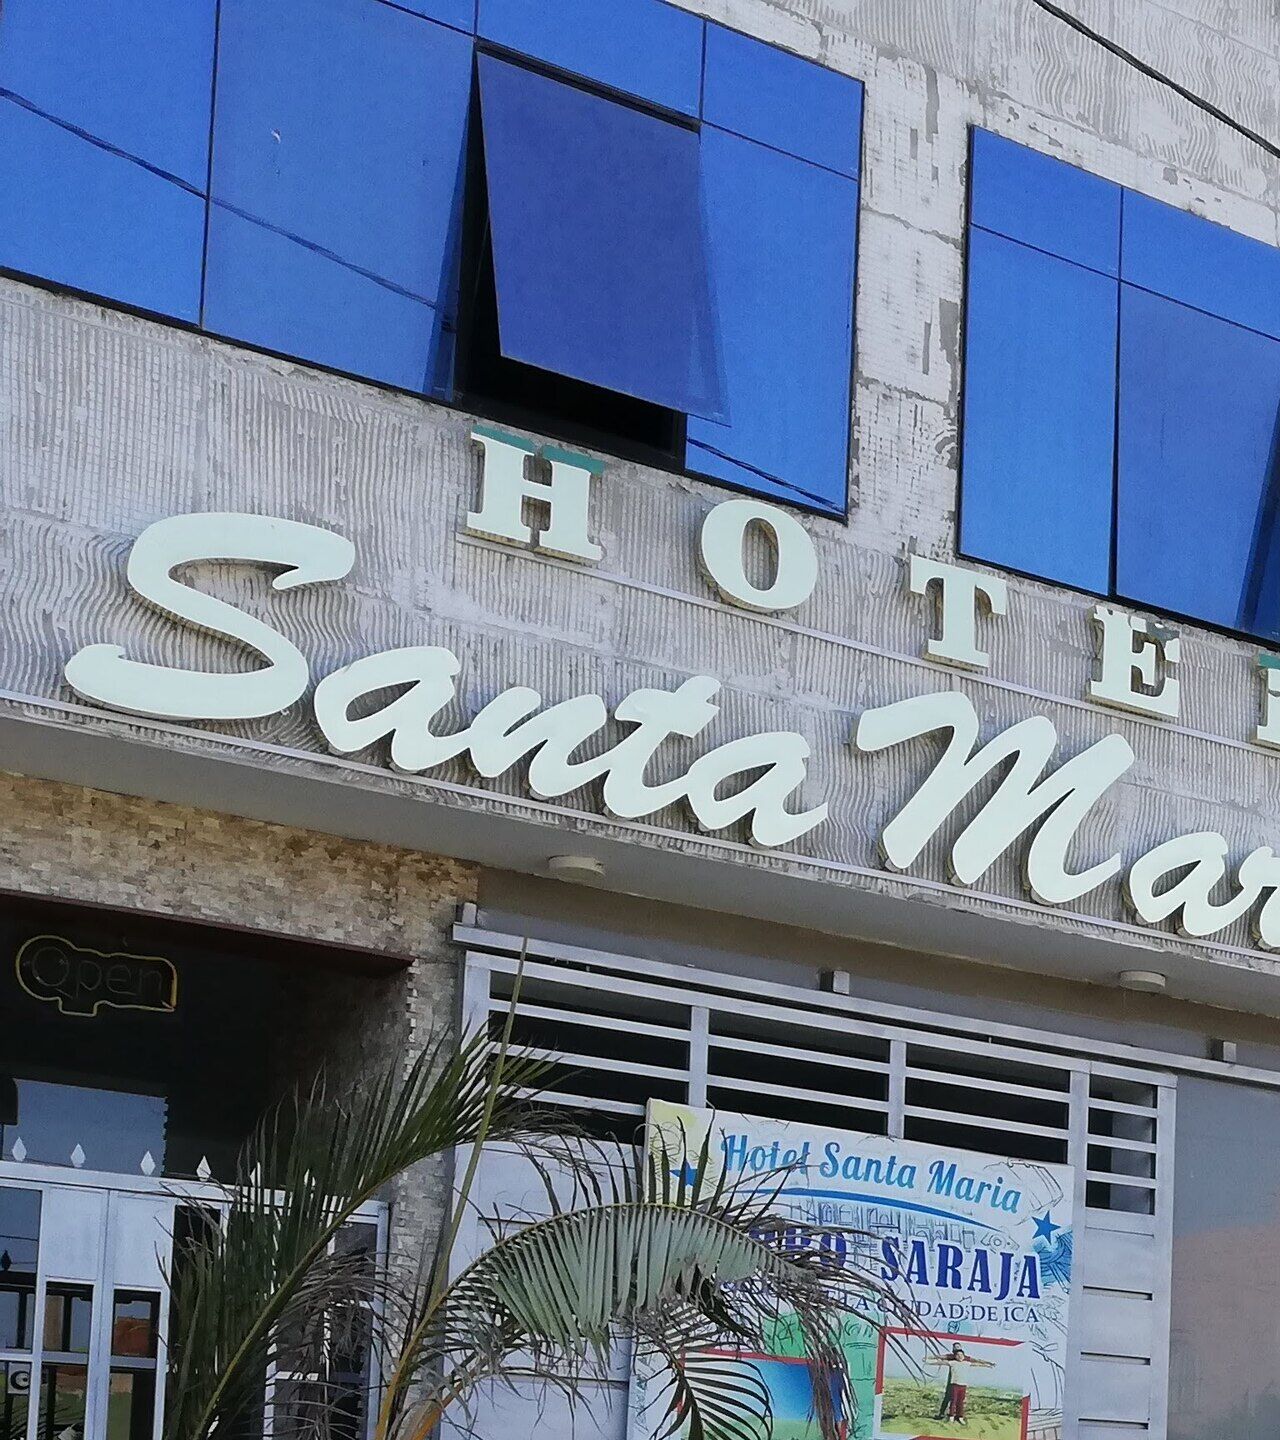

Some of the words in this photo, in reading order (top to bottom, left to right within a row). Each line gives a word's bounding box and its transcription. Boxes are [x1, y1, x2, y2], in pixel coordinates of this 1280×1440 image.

[64, 511, 826, 847] Santa
[31, 946, 164, 1000] Open
[721, 1133, 810, 1174] Hotel
[820, 1142, 916, 1189] Santa
[928, 1160, 1021, 1213] Maria
[881, 1235, 1041, 1300] SARAJA
[970, 1304, 998, 1322] DE
[1004, 1307, 1039, 1323] ICA
